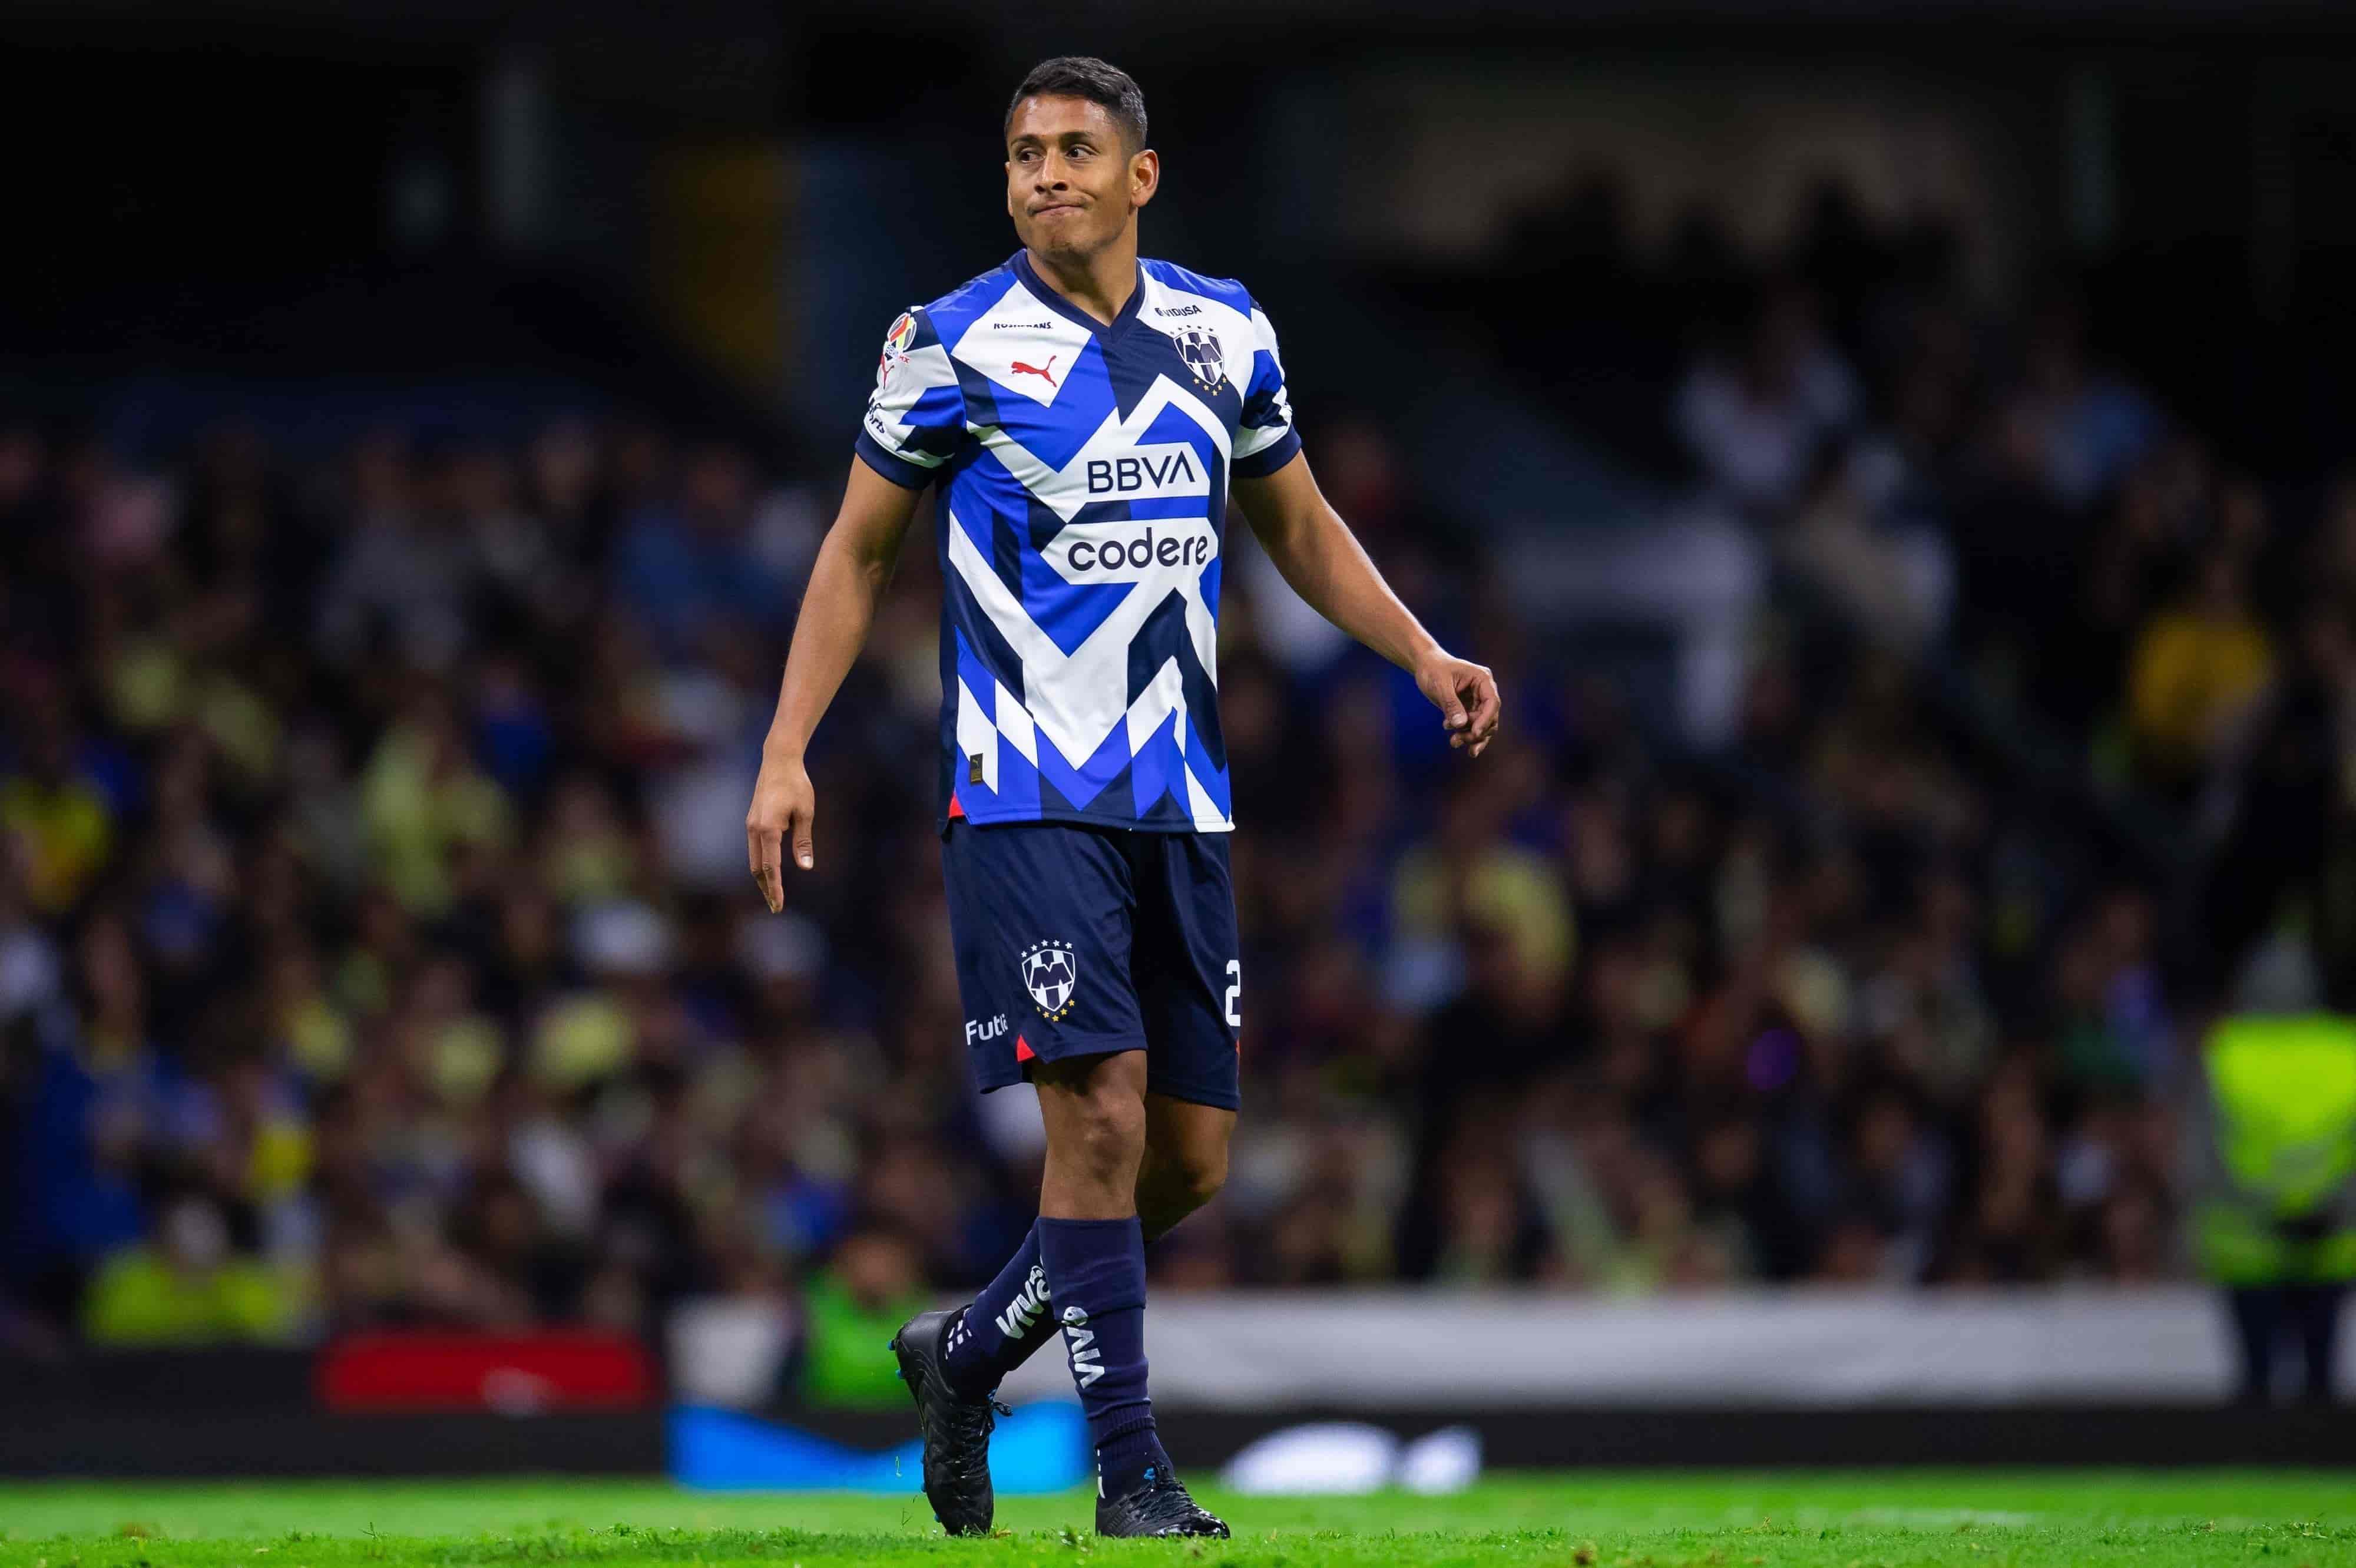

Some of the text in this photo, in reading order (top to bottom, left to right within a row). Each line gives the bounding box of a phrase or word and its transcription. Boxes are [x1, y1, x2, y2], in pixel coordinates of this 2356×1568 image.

[1087, 450, 1196, 494] BBVA
[1068, 527, 1208, 571] codere
[1226, 960, 1240, 1027] 2
